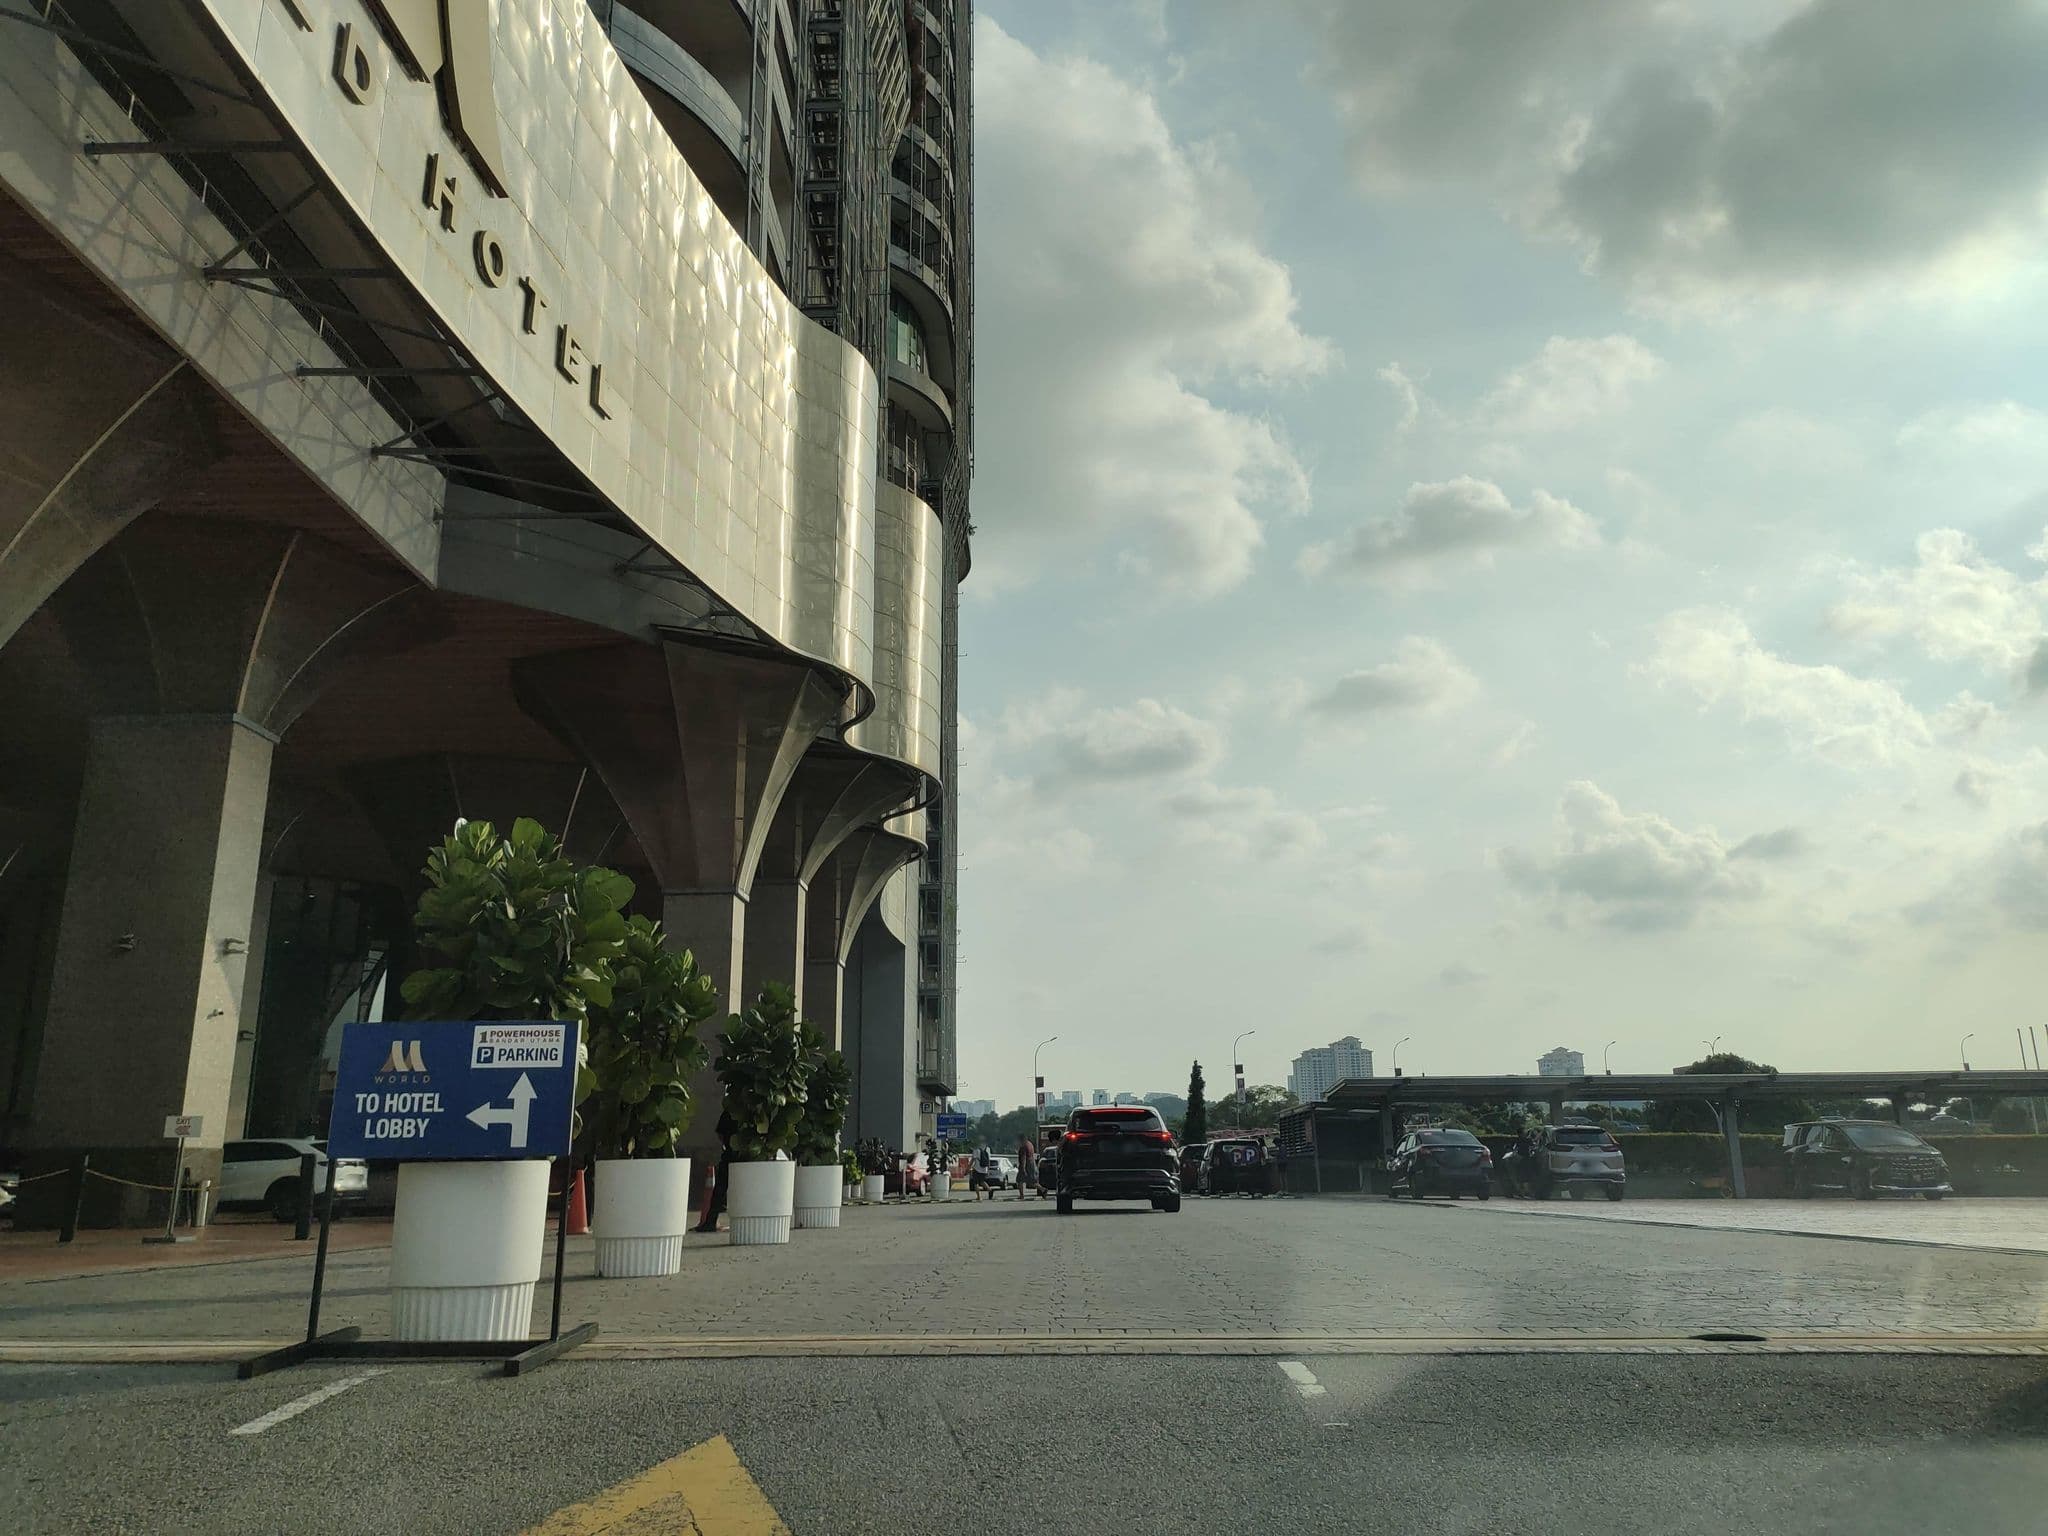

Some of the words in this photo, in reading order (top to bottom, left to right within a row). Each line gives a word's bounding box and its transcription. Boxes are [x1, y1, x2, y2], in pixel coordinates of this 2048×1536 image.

[423, 152, 612, 421] HOTEL
[490, 1029, 561, 1038] POWERHOUSE
[497, 1047, 559, 1062] PARKING
[374, 1076, 431, 1085] WORLD
[355, 1093, 380, 1114] TO
[384, 1092, 445, 1113] HOTEL
[364, 1118, 430, 1139] LOBBY
